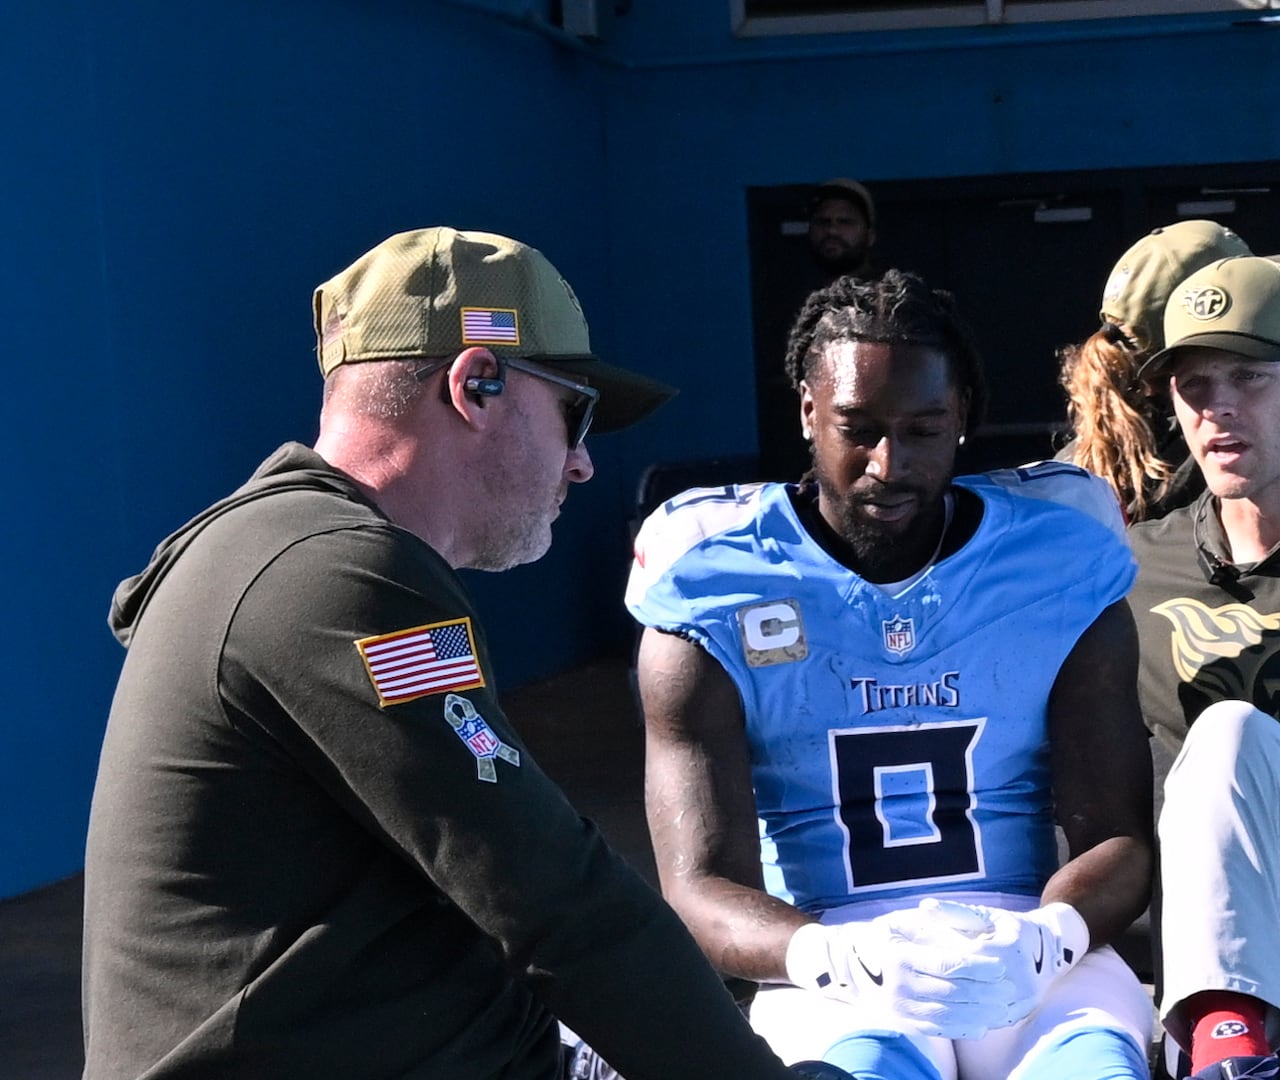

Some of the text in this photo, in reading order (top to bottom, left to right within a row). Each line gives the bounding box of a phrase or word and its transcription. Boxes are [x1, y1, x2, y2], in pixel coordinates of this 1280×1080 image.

[743, 603, 800, 650] C
[888, 633, 911, 649] NFL
[851, 672, 960, 713] TITANS
[469, 731, 496, 754] NFL
[828, 718, 988, 895] 0
